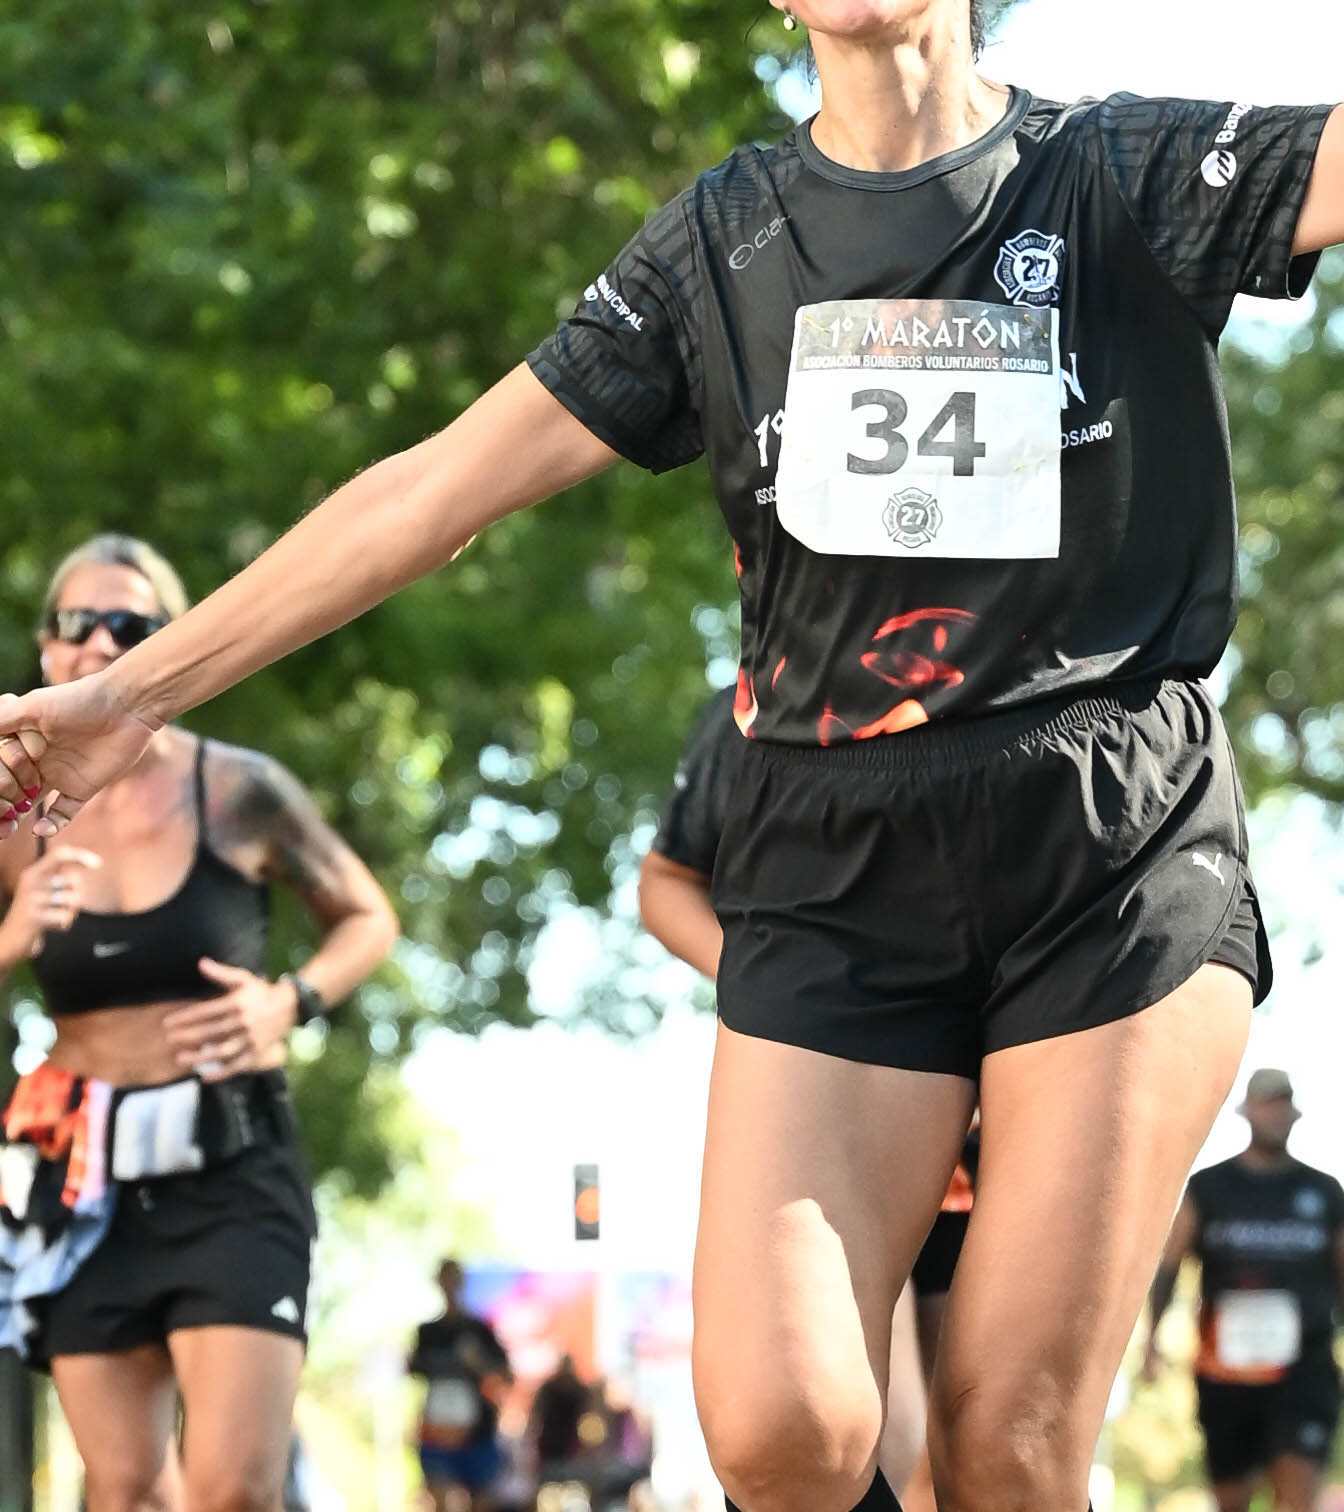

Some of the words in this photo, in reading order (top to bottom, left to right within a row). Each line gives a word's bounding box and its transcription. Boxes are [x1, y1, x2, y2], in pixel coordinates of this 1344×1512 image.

[860, 309, 1021, 349] MARATÓN
[862, 354, 923, 369] BOMBEROS
[924, 355, 999, 370] VOLUNTARIOS
[1001, 356, 1050, 373] ROSARIO
[846, 388, 986, 477] 34
[1061, 420, 1113, 449] OSARIO
[901, 505, 926, 526] 27
